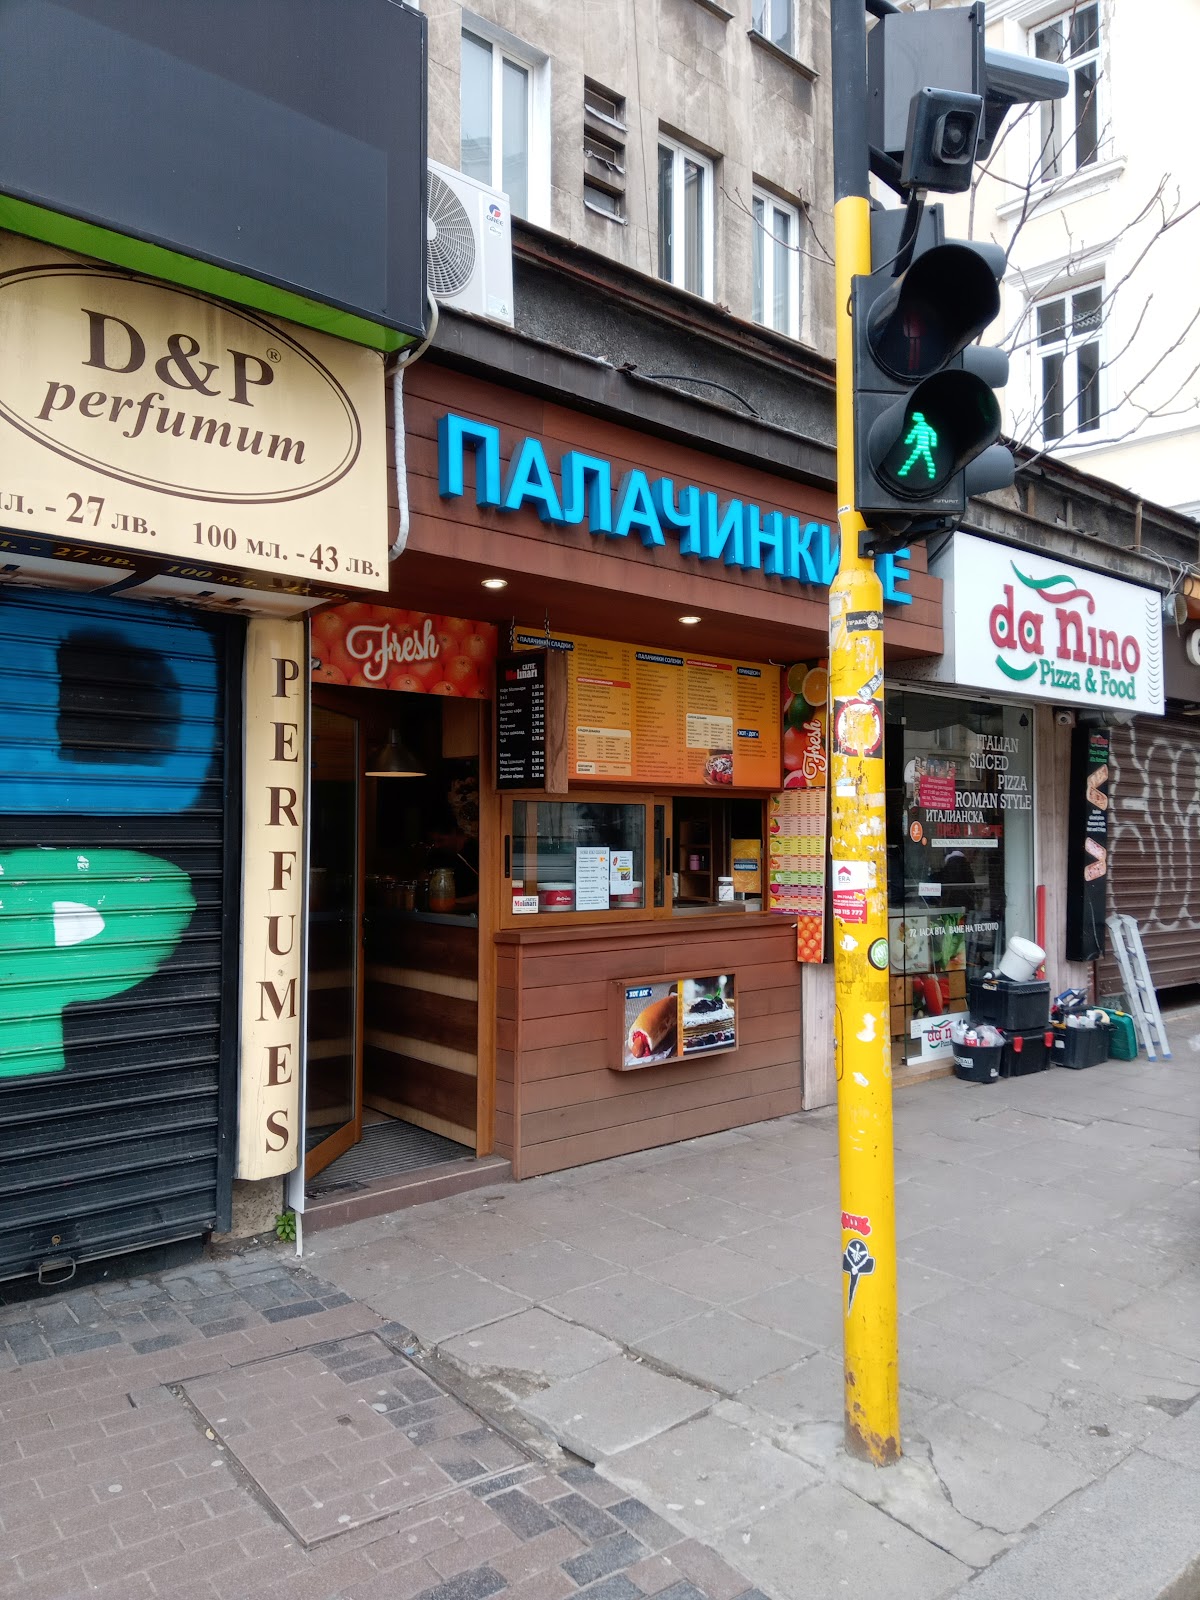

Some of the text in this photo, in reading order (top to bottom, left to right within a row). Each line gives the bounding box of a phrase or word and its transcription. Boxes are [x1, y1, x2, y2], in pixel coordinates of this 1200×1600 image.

[486, 215, 503, 226] GREE
[81, 308, 274, 407] D&P
[34, 379, 306, 465] perfumum
[66, 491, 106, 527] 27
[111, 513, 156, 537] лв.
[193, 521, 237, 551] 100
[246, 535, 289, 561] мл.
[345, 557, 380, 577] лв.
[53, 547, 89, 560] 27
[167, 565, 213, 579] 100
[989, 583, 1044, 655] da
[1055, 607, 1141, 674] nino
[346, 618, 440, 681] Fresh
[1039, 658, 1136, 700] Pizza & Food
[802, 719, 827, 779] Fresh
[969, 752, 1009, 771] SLICED
[976, 733, 1019, 753] ITALIAN
[955, 791, 1032, 810] ROMAN STYLE
[998, 774, 1028, 791] PIZZA
[926, 809, 985, 824] ИТАЛИАНСКА
[255, 657, 300, 1155] PERFUMES
[965, 924, 974, 933] НА
[974, 922, 999, 932] ТЕСТОТО
